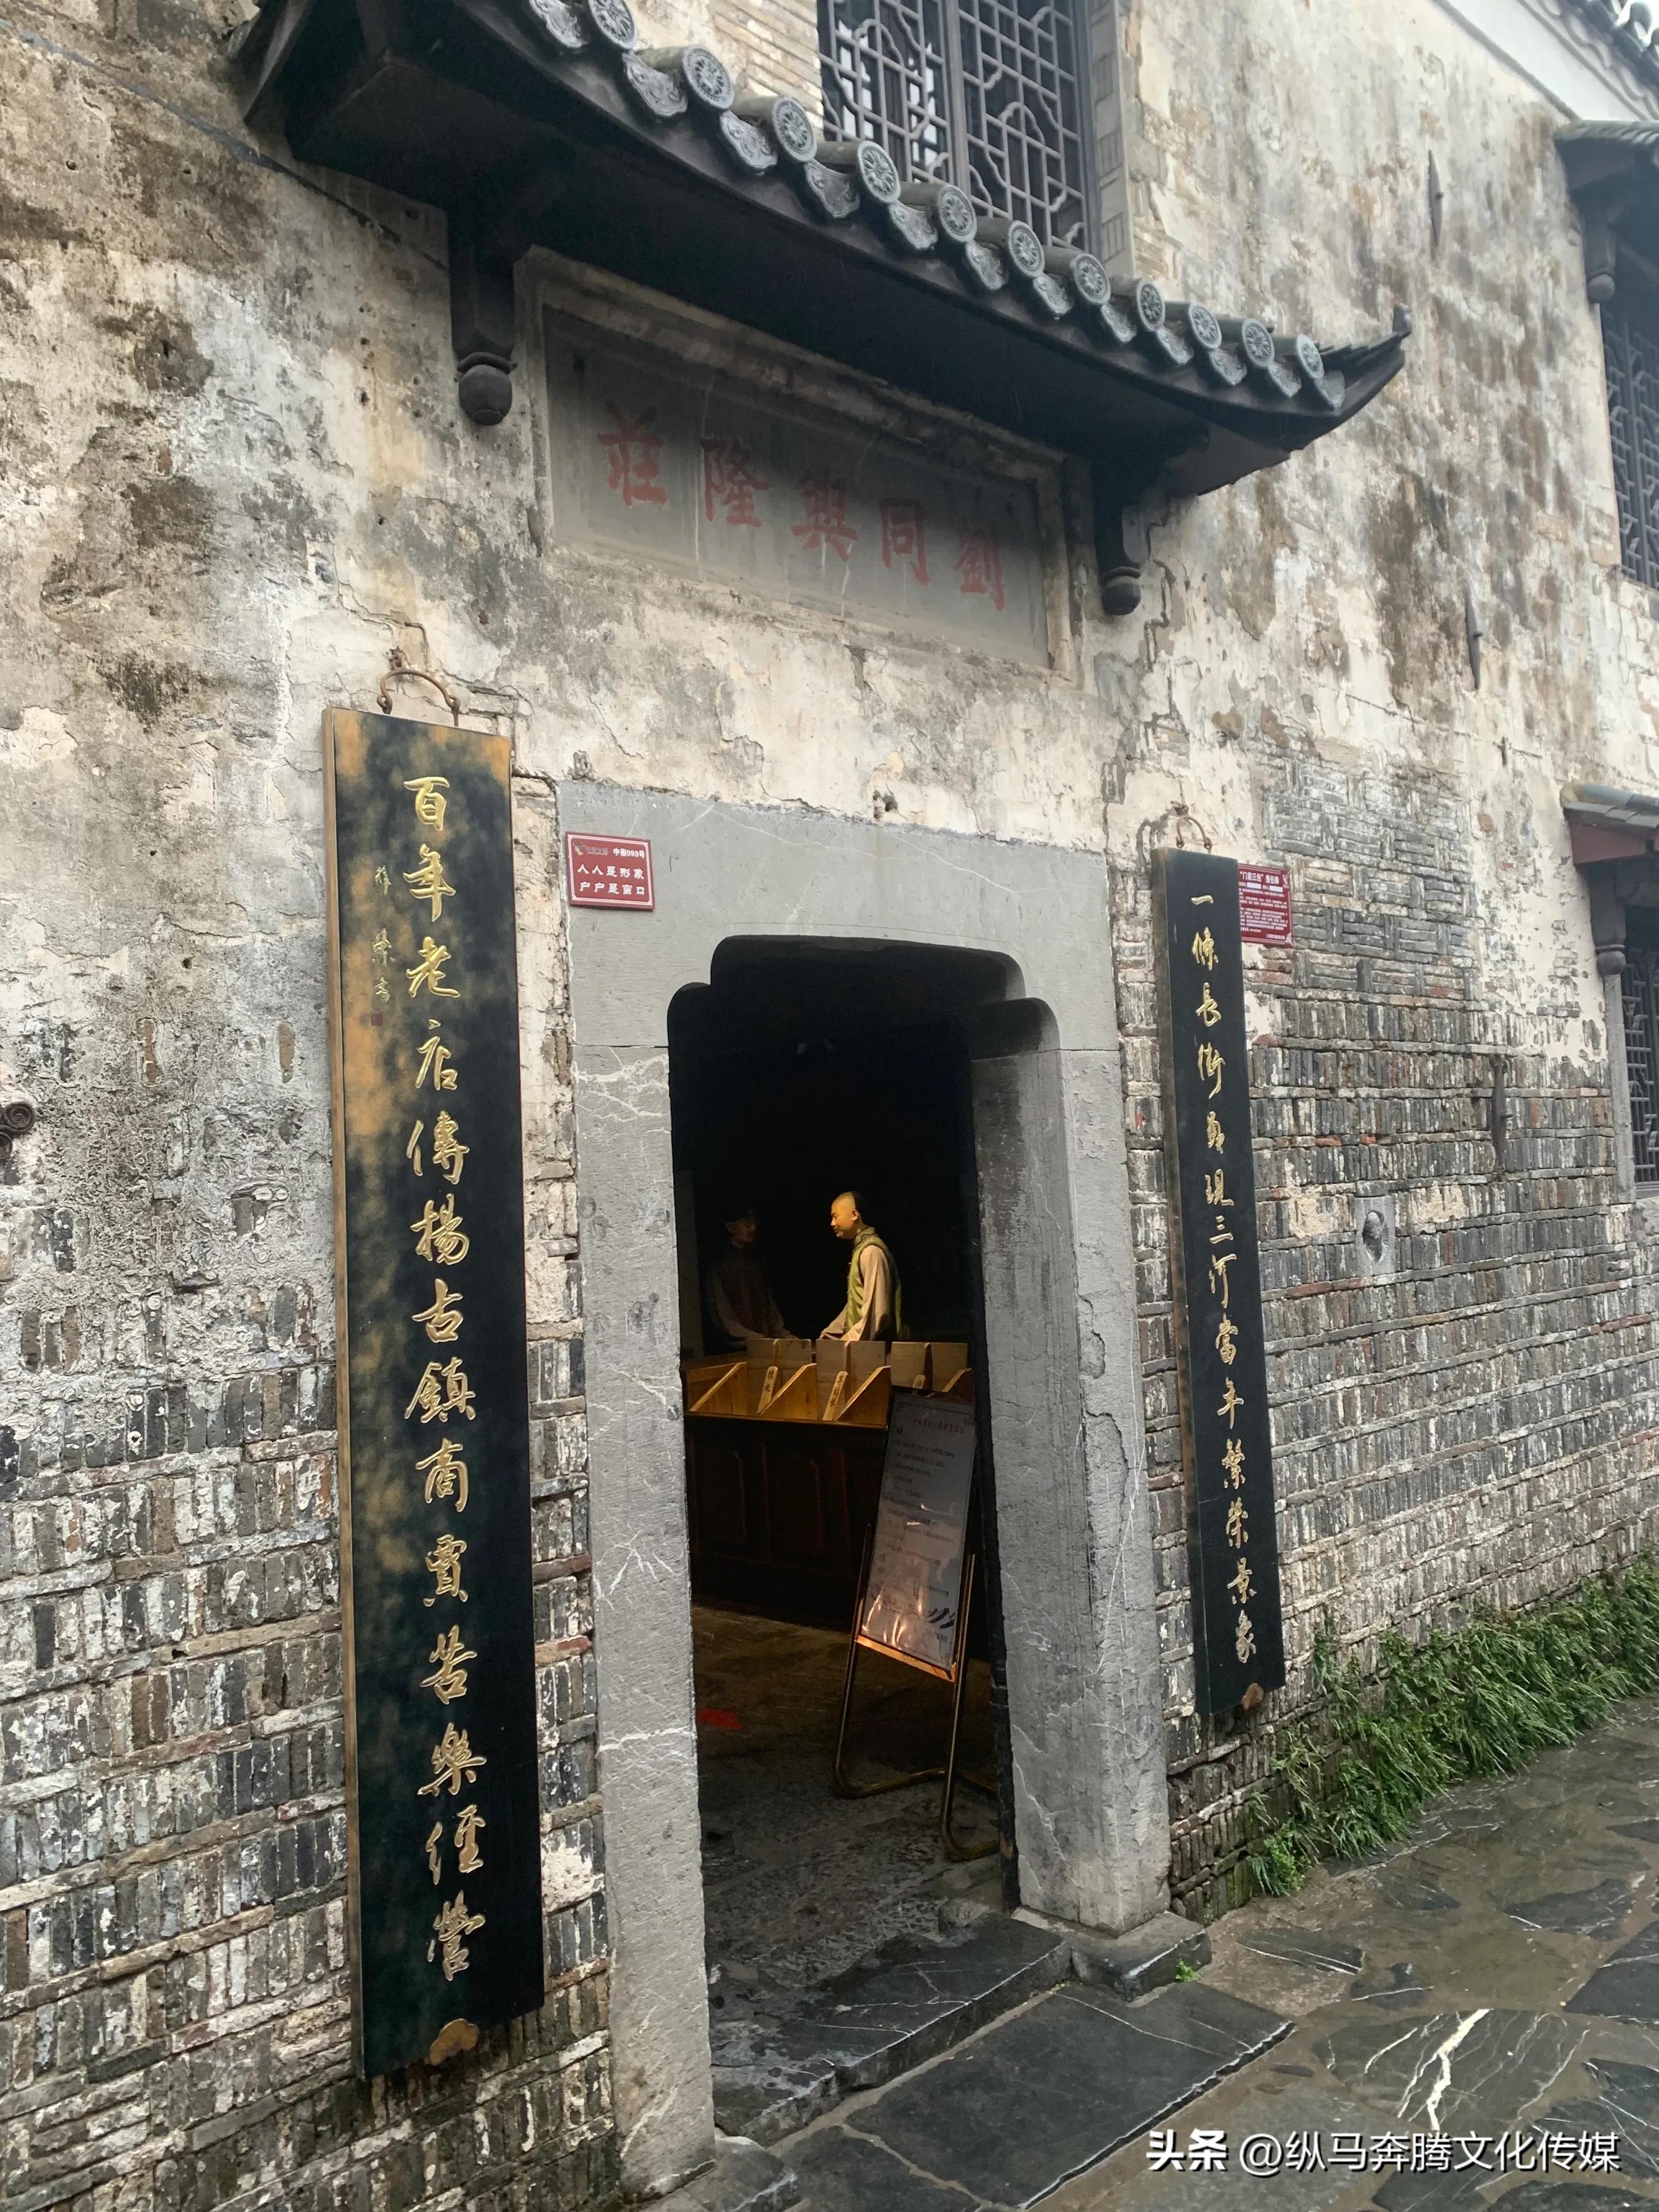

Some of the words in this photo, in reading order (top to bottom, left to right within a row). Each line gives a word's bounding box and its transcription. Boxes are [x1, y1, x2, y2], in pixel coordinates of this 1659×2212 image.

[613, 847, 645, 858] 中街093号
[577, 863, 645, 879] 人人是形象
[579, 881, 645, 895] 户户是窗口
